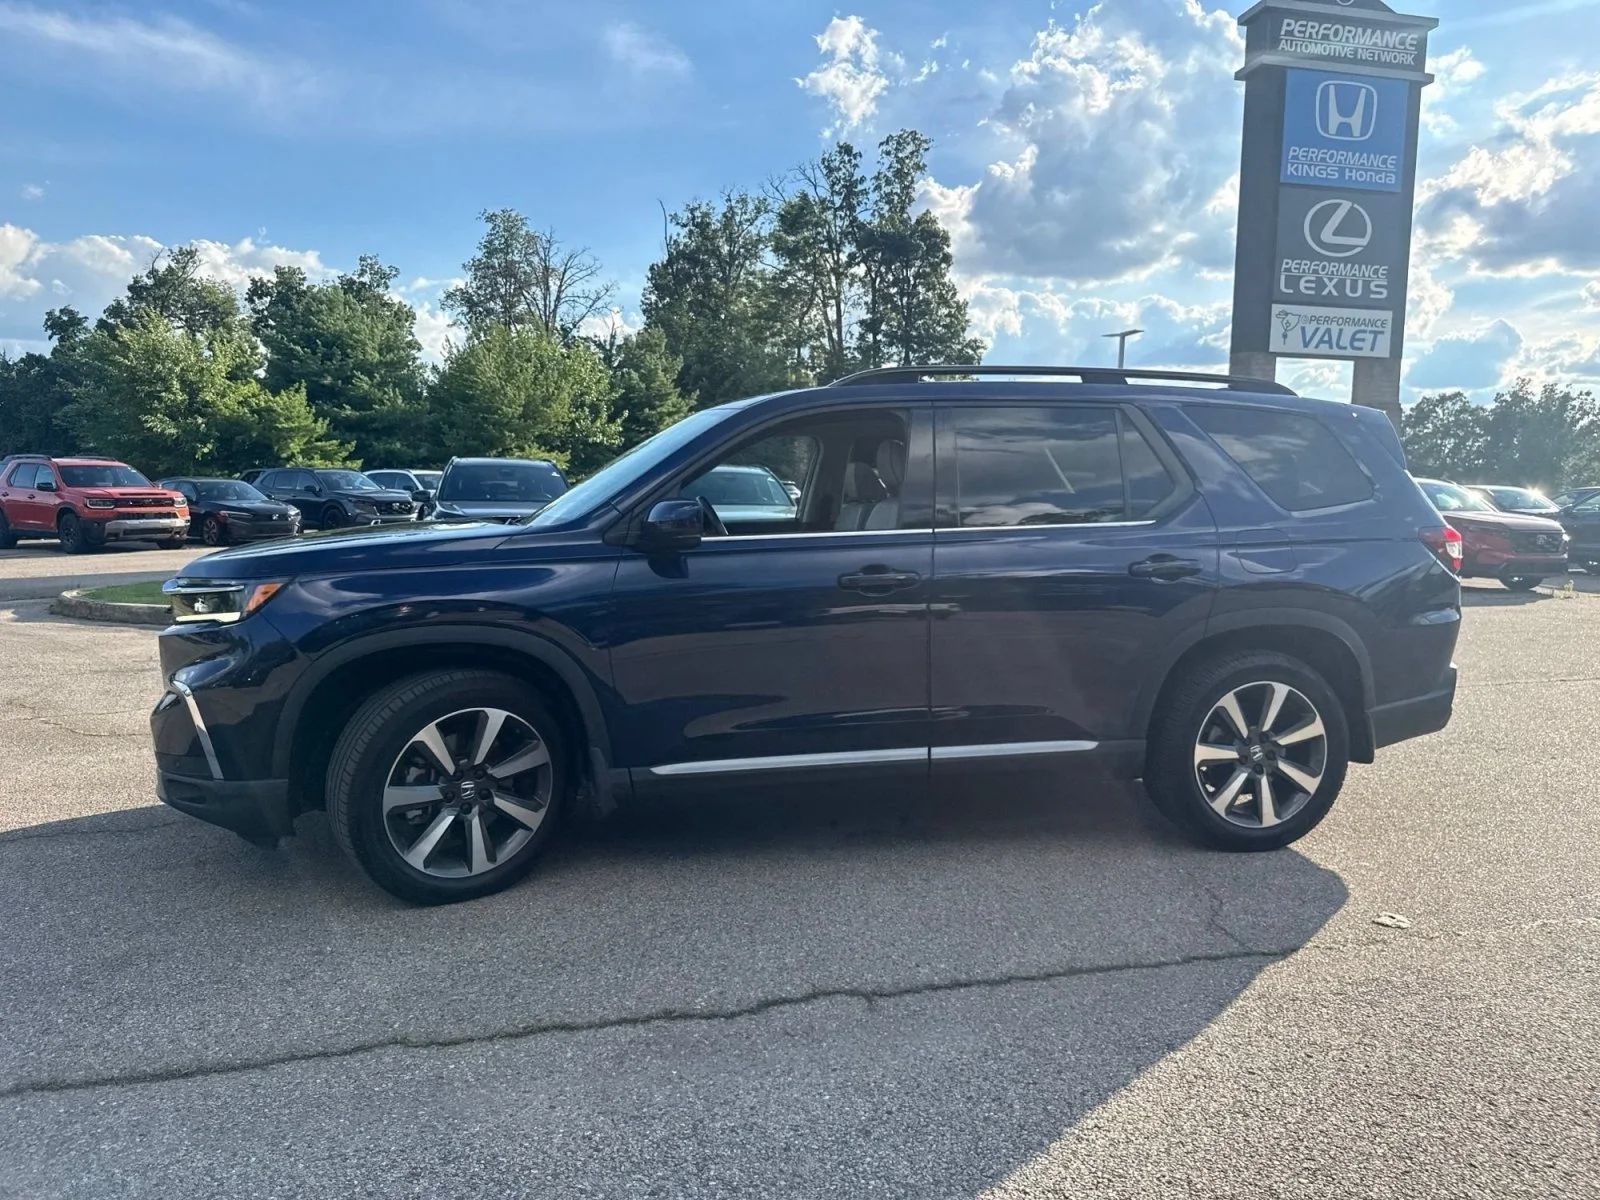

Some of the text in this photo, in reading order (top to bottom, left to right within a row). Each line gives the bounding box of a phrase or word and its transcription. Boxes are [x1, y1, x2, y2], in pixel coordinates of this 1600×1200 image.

[1280, 19, 1418, 50] PERFORMANCE
[1279, 40, 1415, 65] AUTOMOTIVE NETWORK
[1288, 146, 1397, 169] PERFORMANCE
[1287, 164, 1396, 184] KINGS Honda
[1281, 259, 1388, 278] PERFORMANCE
[1279, 275, 1388, 299] LEXUS
[1308, 315, 1388, 329] PERFORMANCE
[1300, 326, 1385, 352] VALET
